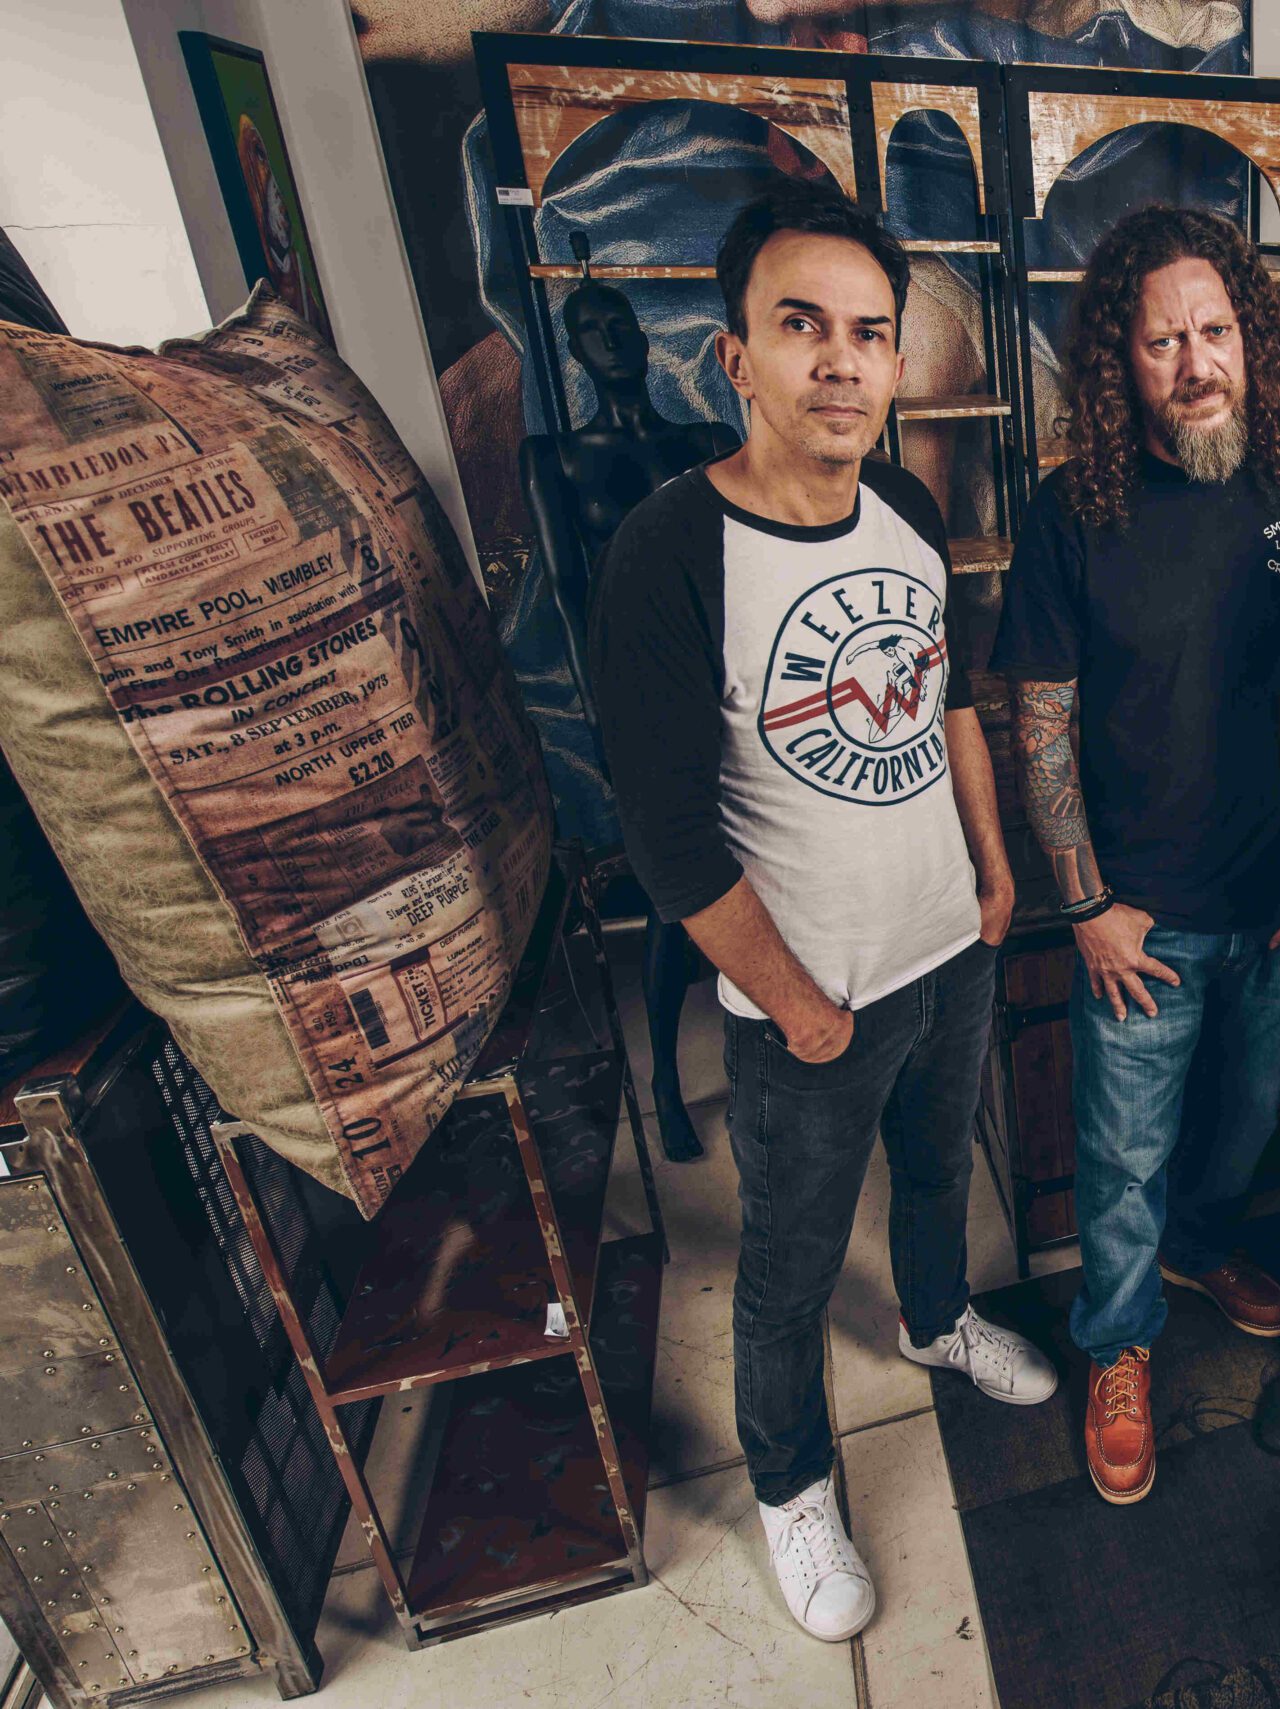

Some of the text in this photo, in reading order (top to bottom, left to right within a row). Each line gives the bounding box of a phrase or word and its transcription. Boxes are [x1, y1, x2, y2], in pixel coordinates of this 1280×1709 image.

[35, 514, 115, 567] THE
[128, 469, 256, 543] BEATLES
[77, 517, 256, 578] AND TWO SUPPORTING GROUPS
[96, 553, 335, 648] EMPIRE POOL, WEMBLEY
[144, 657, 175, 674] and
[181, 643, 219, 666] Tony
[223, 625, 265, 649] Smith
[268, 619, 283, 633] in
[286, 595, 337, 625] association
[338, 583, 359, 599] with
[213, 632, 292, 671] Productions
[780, 580, 943, 682] WEEZER
[117, 617, 378, 723] The ROLLING STONES
[231, 669, 338, 724] IN CONCERT
[230, 733, 246, 748] 8
[249, 690, 360, 742] SEPTEMBER,
[360, 674, 390, 698] 1973
[273, 722, 342, 755] at 3 p.m.
[274, 711, 417, 787] NORTH UPPER TIER
[348, 750, 396, 787] £2.20
[785, 728, 943, 795] CALIFORNIA
[406, 878, 470, 927] DEEP PURPLE
[440, 932, 457, 948] DEEP
[411, 981, 436, 1029] TICKET
[328, 1056, 364, 1089] 24
[343, 1117, 391, 1161] 10
